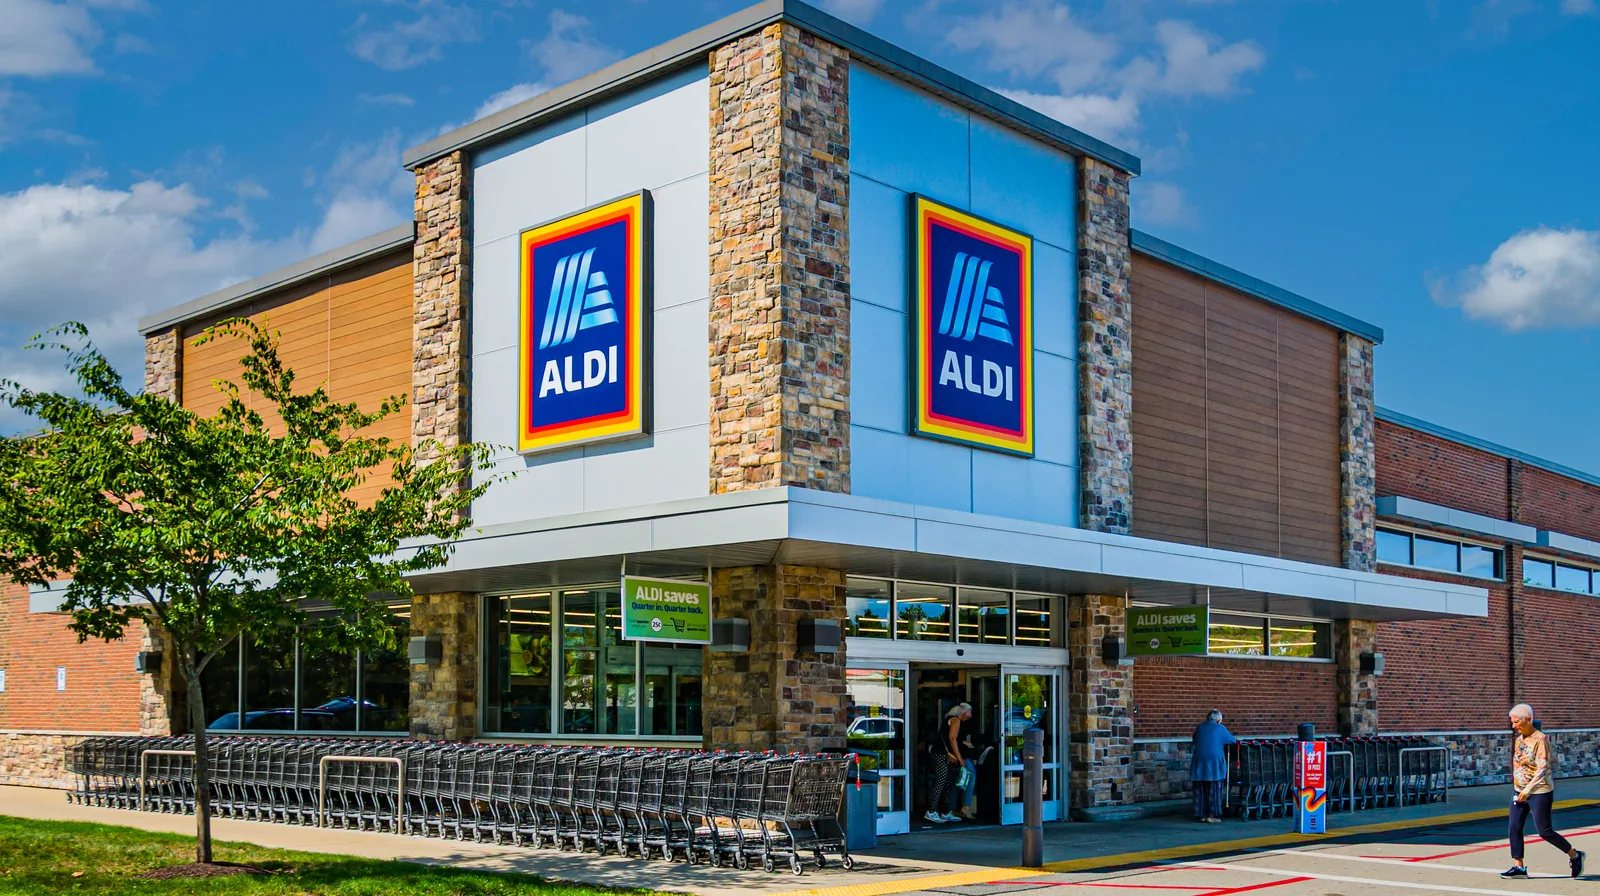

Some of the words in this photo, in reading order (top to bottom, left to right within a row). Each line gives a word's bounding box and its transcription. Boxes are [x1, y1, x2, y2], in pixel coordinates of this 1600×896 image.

[539, 345, 617, 398] ALDI
[939, 350, 1013, 402] ALDI
[636, 586, 662, 601] ALDI
[664, 591, 699, 604] saves
[632, 602, 655, 611] Quarter
[664, 605, 687, 613] Quarter
[688, 606, 703, 614] back.
[1137, 614, 1161, 626] ALDI
[1162, 614, 1196, 625] saves
[1307, 751, 1322, 764] #1
